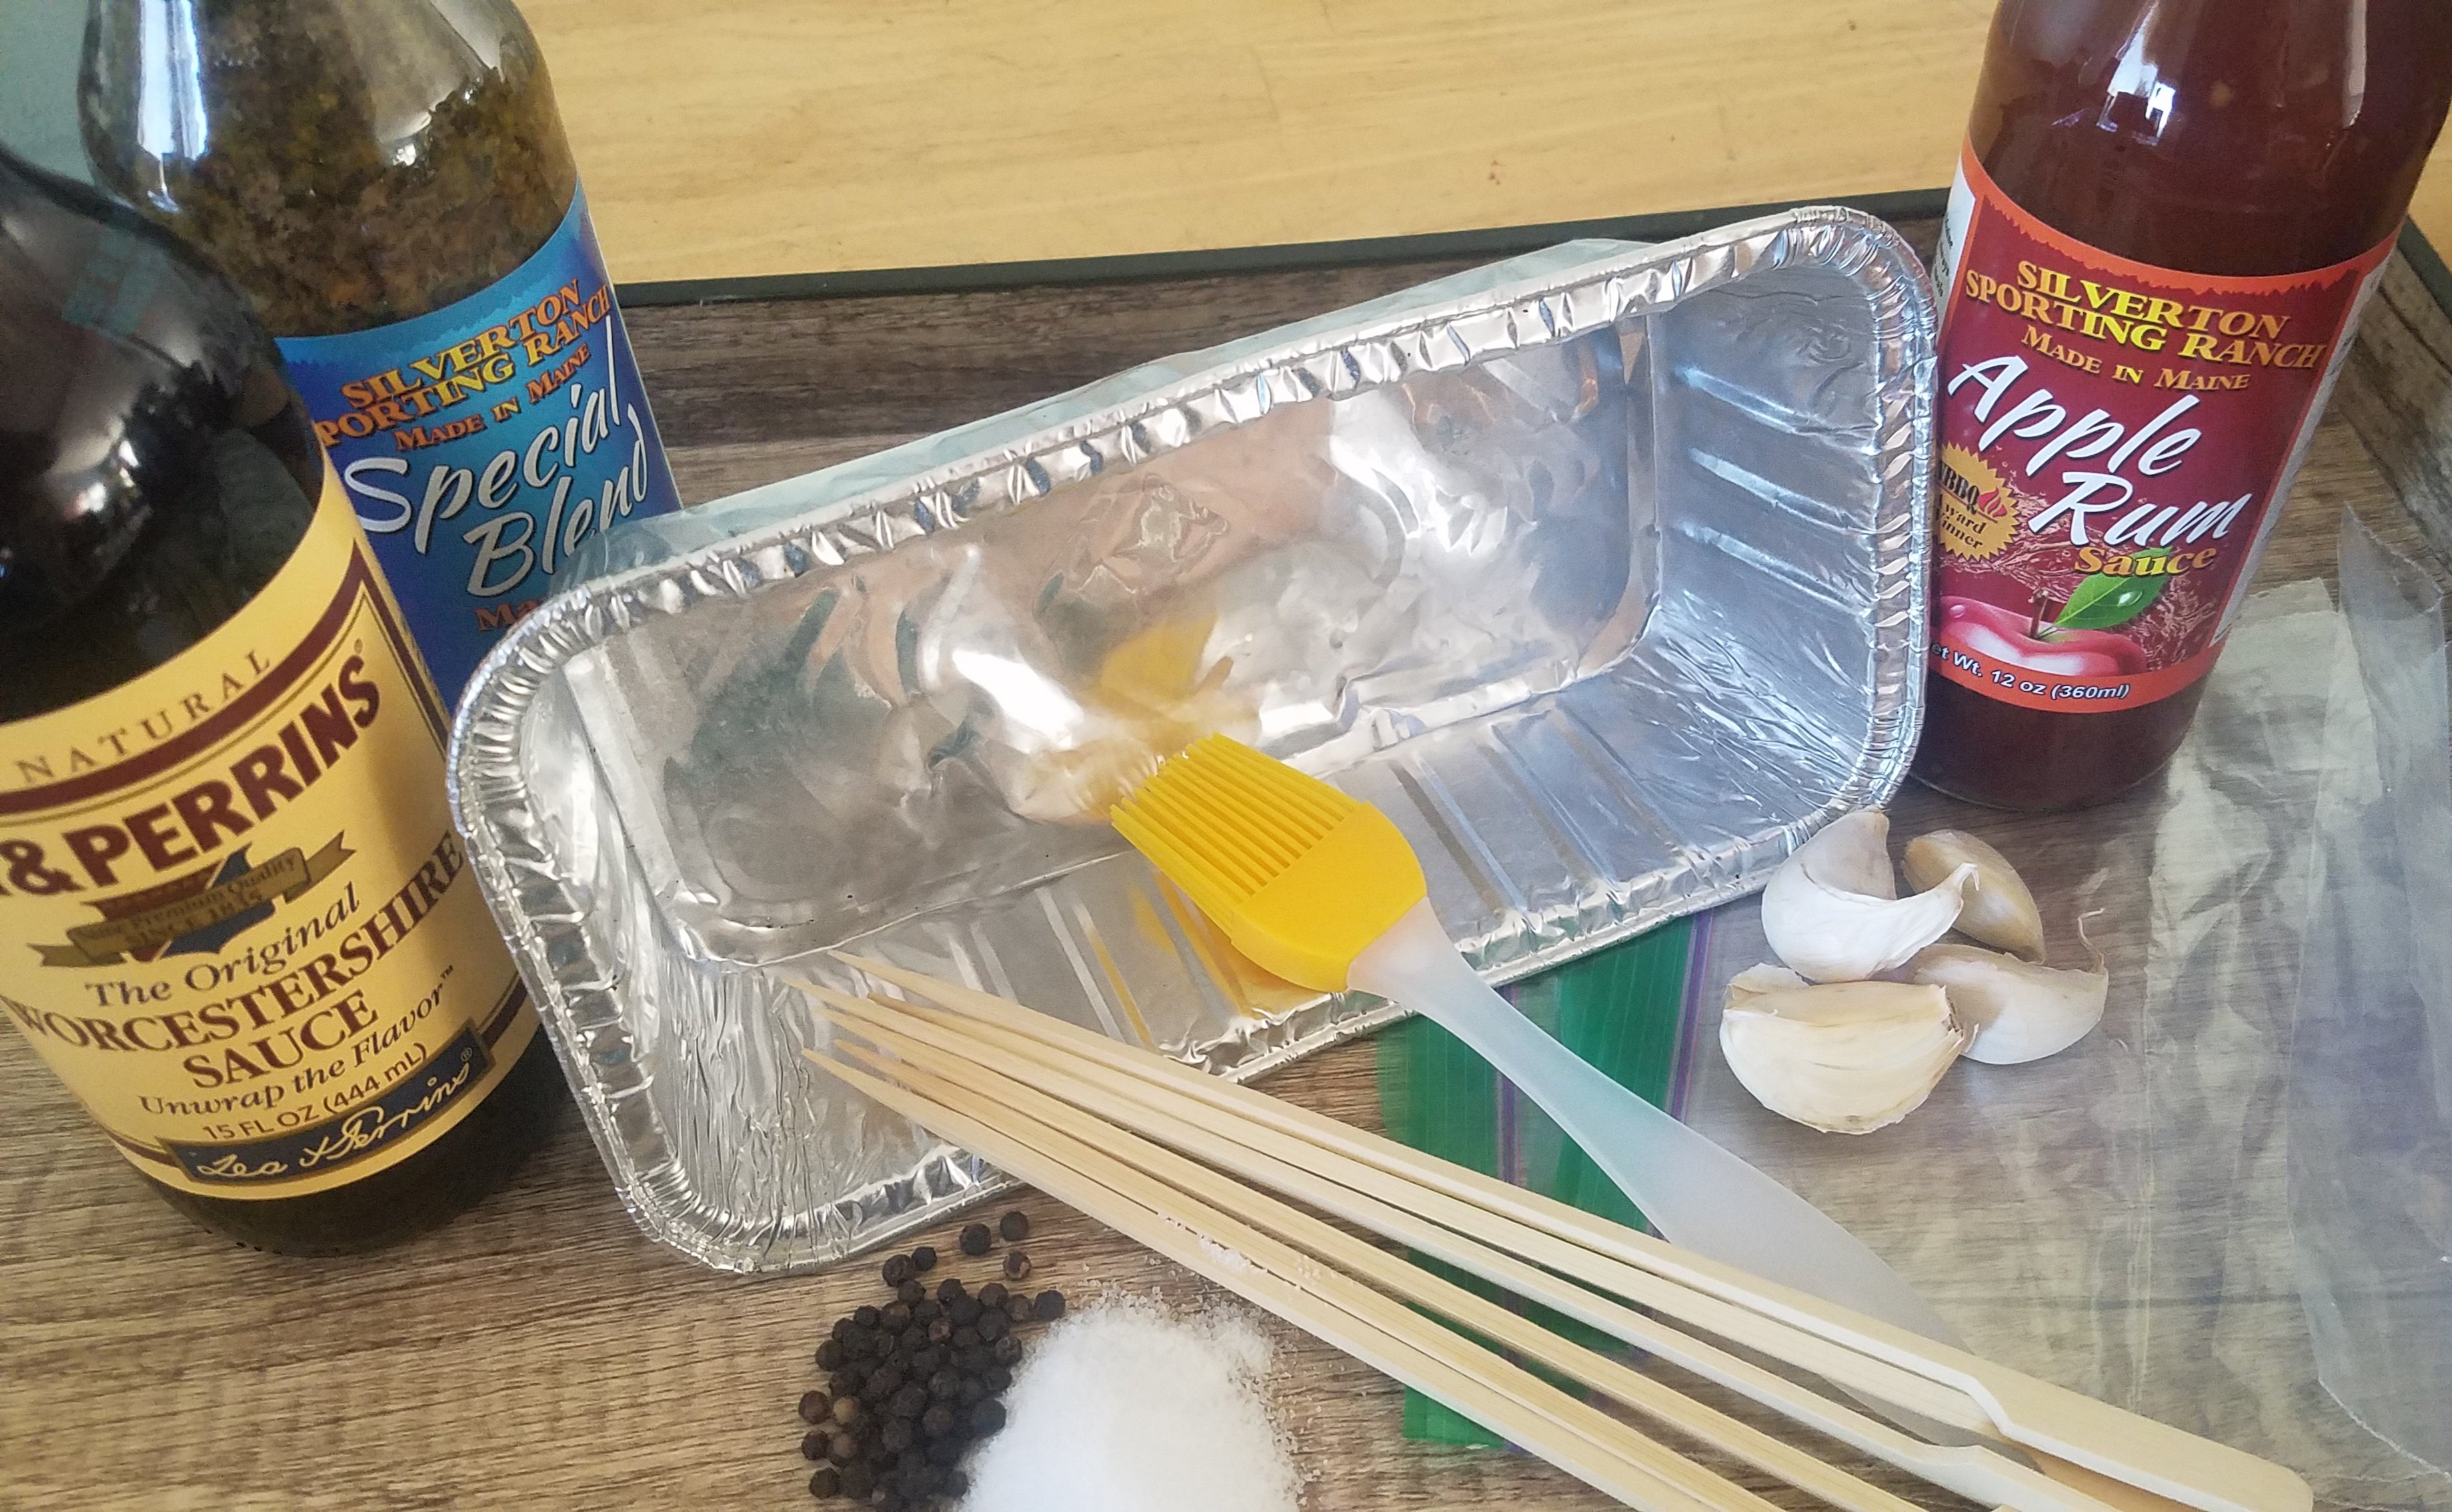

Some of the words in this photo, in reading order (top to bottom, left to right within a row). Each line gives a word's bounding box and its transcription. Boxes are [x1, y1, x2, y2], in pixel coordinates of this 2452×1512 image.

[341, 278, 580, 409] SILVERTON
[1966, 269, 2167, 352] SPORTING
[2178, 333, 2326, 370] RANCH
[2017, 260, 2290, 339] SILVERTON
[314, 353, 515, 447] PORTING
[521, 283, 609, 366] RANCH
[492, 397, 519, 421] IN
[2113, 363, 2143, 384] IN
[344, 314, 621, 555] Special
[1947, 355, 2201, 477] Apple
[463, 403, 648, 597] Blend
[2029, 471, 2252, 547] Rum
[2074, 546, 2217, 577] Sauce
[15, 650, 271, 783] NATURAL
[1931, 642, 1949, 660] et
[1953, 651, 1983, 677] Wt.
[1991, 669, 2015, 688] 12
[2019, 681, 2047, 695] oz
[2051, 683, 2131, 700] (360ml)
[0, 829, 463, 1052] WORCESTERSHIRE
[85, 979, 172, 1008] The
[183, 880, 362, 991] Original
[137, 1081, 285, 1116] Unwrap
[291, 1060, 346, 1095] the
[183, 989, 379, 1089] SAUCE
[202, 1125, 235, 1141] 15
[241, 1118, 274, 1137] FL
[277, 1104, 320, 1128] OZ
[323, 1077, 381, 1115] (444
[384, 1042, 428, 1083] mL)
